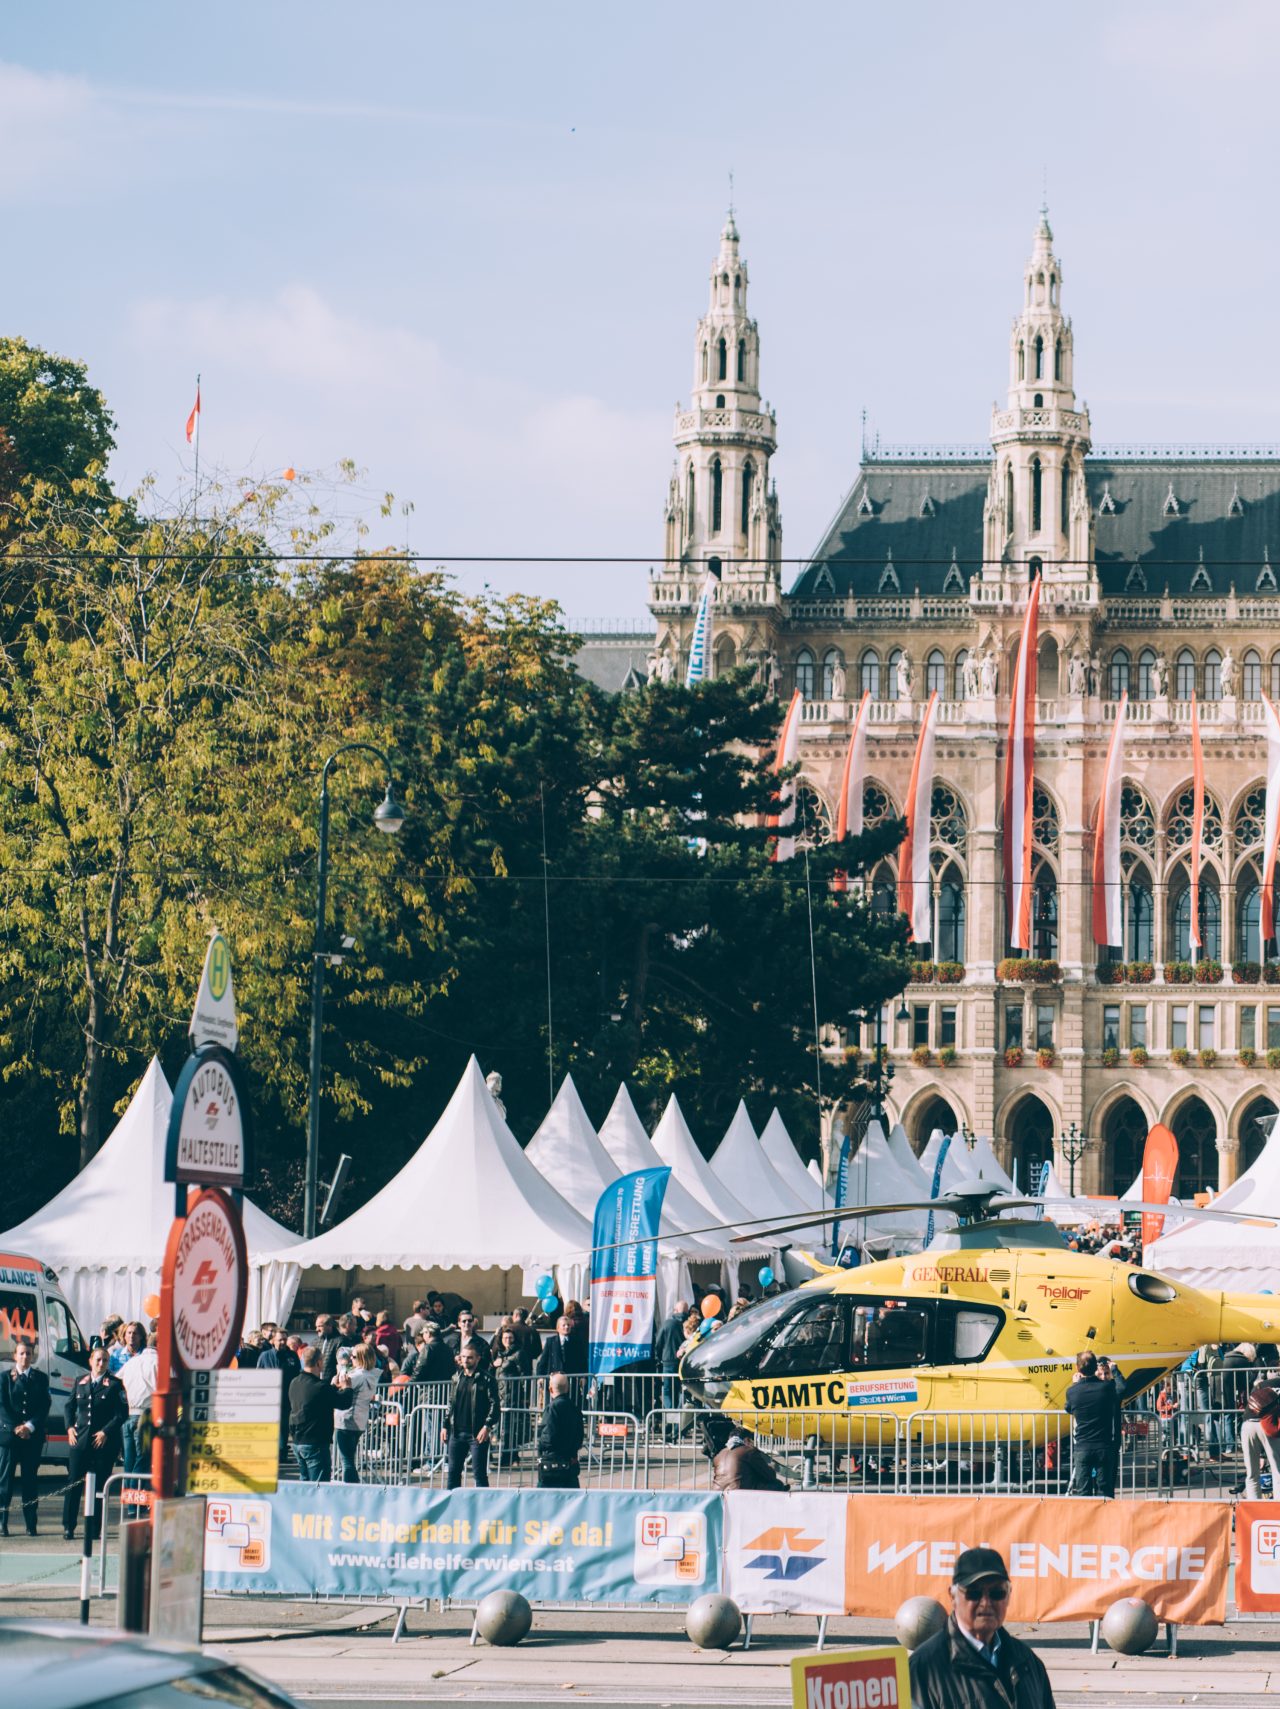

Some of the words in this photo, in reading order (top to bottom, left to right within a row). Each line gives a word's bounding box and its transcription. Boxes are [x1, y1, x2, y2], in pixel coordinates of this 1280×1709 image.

[191, 1068, 234, 1117] AUTOBUS
[180, 1136, 240, 1169] HALTESTELLE
[627, 1177, 646, 1274] BERUFSRETTUNG
[175, 1213, 236, 1275] STRASSENBAHN
[642, 1244, 651, 1275] WIEN
[912, 1266, 989, 1283] GENERALI
[175, 1304, 230, 1360] HALTESTELLE
[1028, 1364, 1058, 1374] NOTRUF
[1061, 1363, 1073, 1372] 144
[850, 1381, 915, 1393] BERUFSRETTUNG
[196, 1408, 208, 1417] 71
[191, 1426, 220, 1438] N25
[191, 1443, 222, 1455] N38
[190, 1461, 220, 1473] N60
[190, 1478, 219, 1490] N66
[291, 1514, 332, 1540] Mit
[340, 1514, 471, 1546] Sicherheit
[478, 1518, 519, 1546] für
[524, 1518, 567, 1547] Sie
[571, 1520, 613, 1548] da!
[328, 1551, 576, 1574] www.diehelferwiens.at
[1010, 1543, 1206, 1582] ENERGIE
[806, 1675, 898, 1709] Kronen
